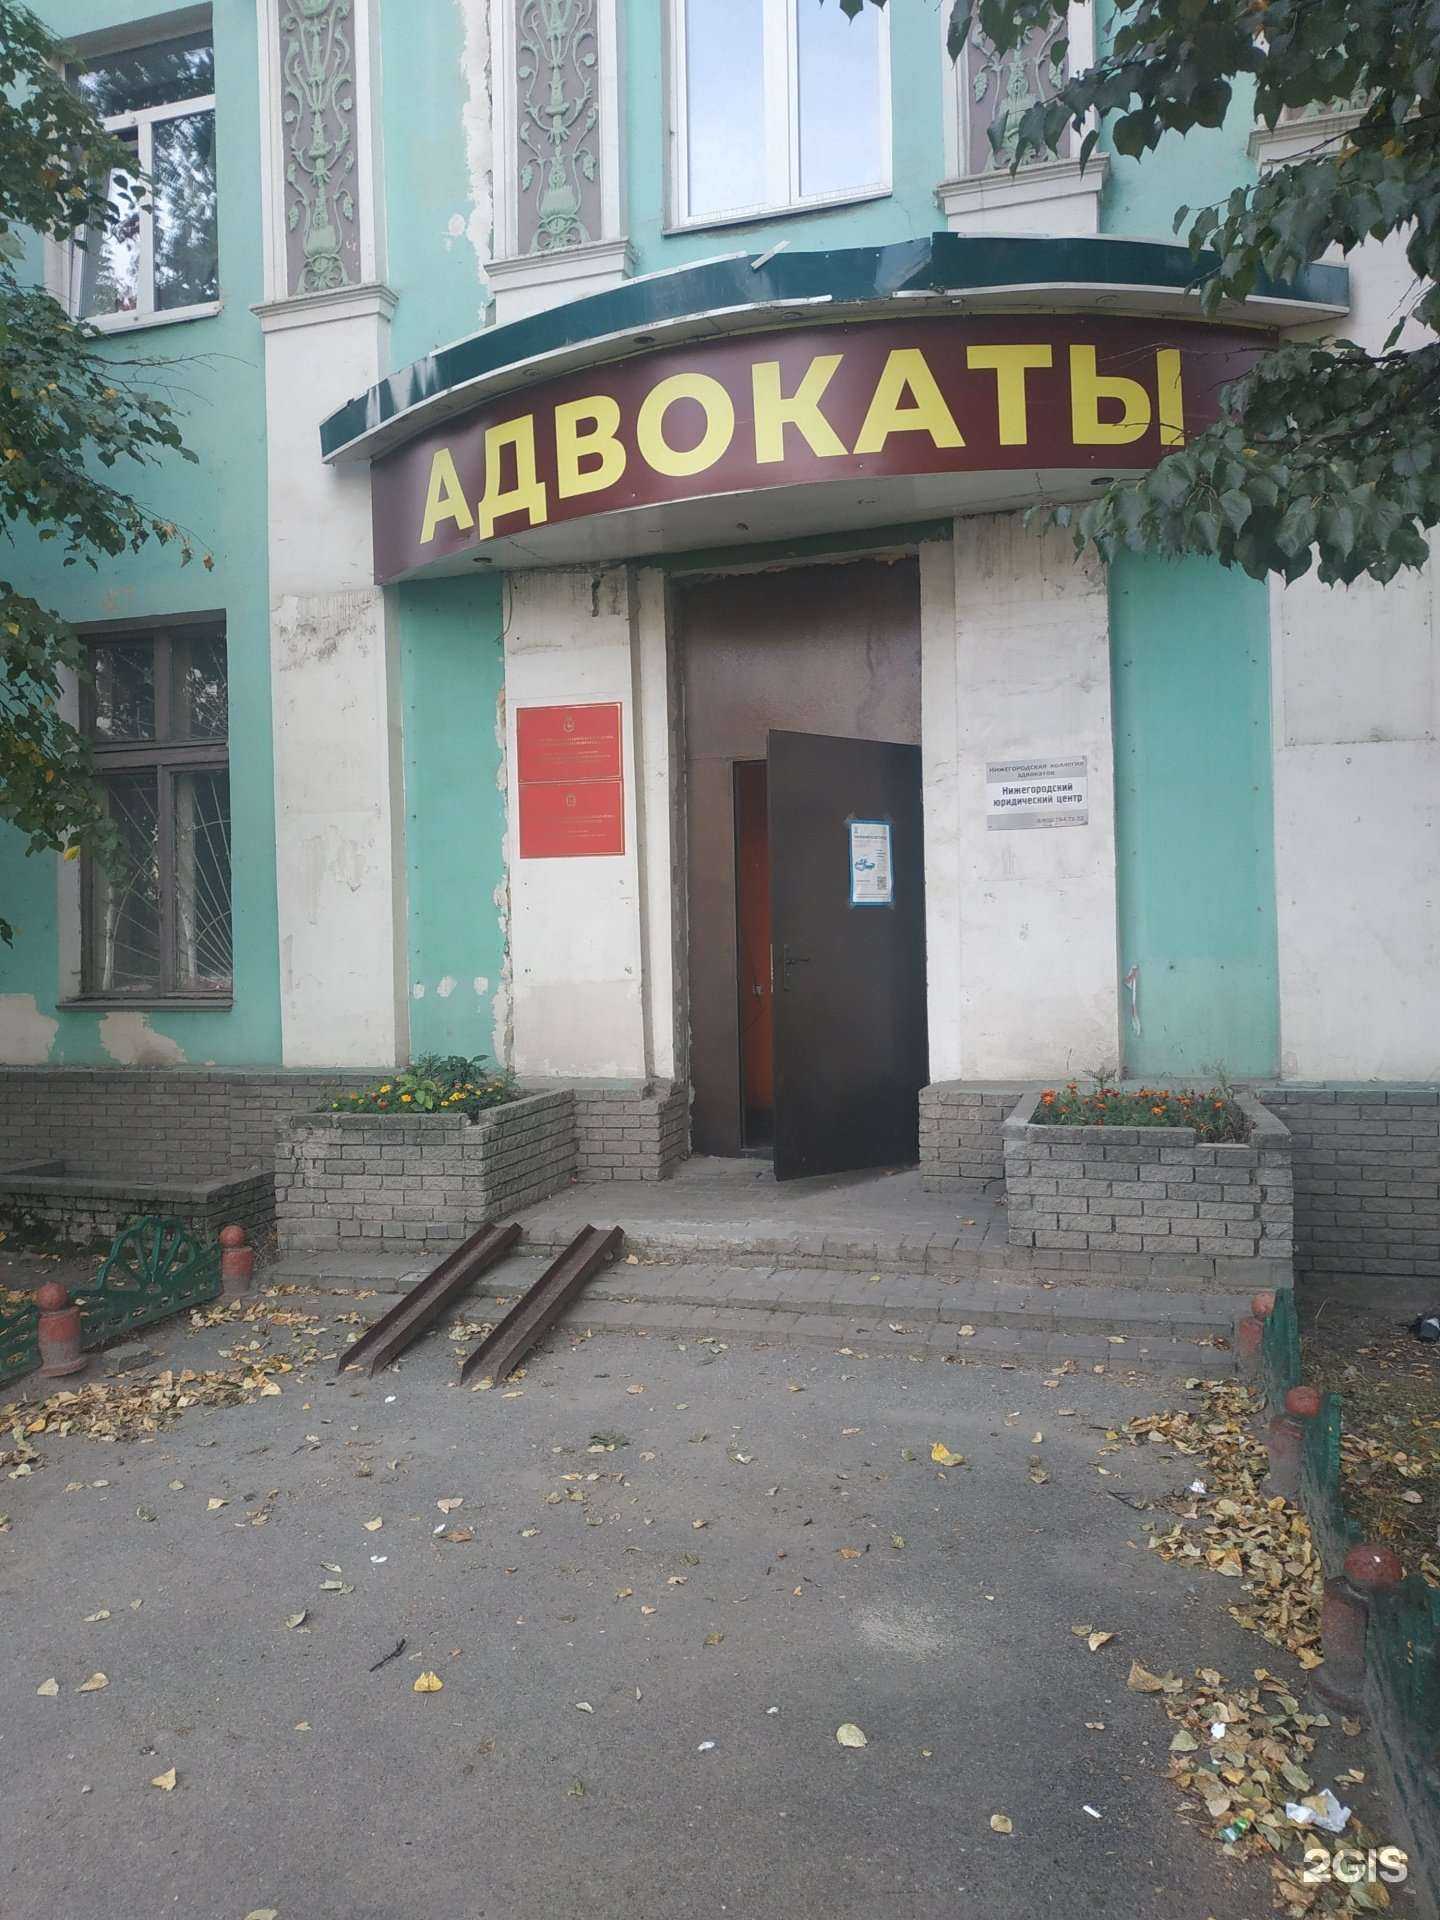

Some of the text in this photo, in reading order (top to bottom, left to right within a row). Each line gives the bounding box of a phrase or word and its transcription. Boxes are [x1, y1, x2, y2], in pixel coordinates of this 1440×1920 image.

[419, 344, 1185, 544] АДВОКАТЫ
[1002, 783, 1073, 795] Нижегородский
[993, 794, 1083, 807] юридический центр
